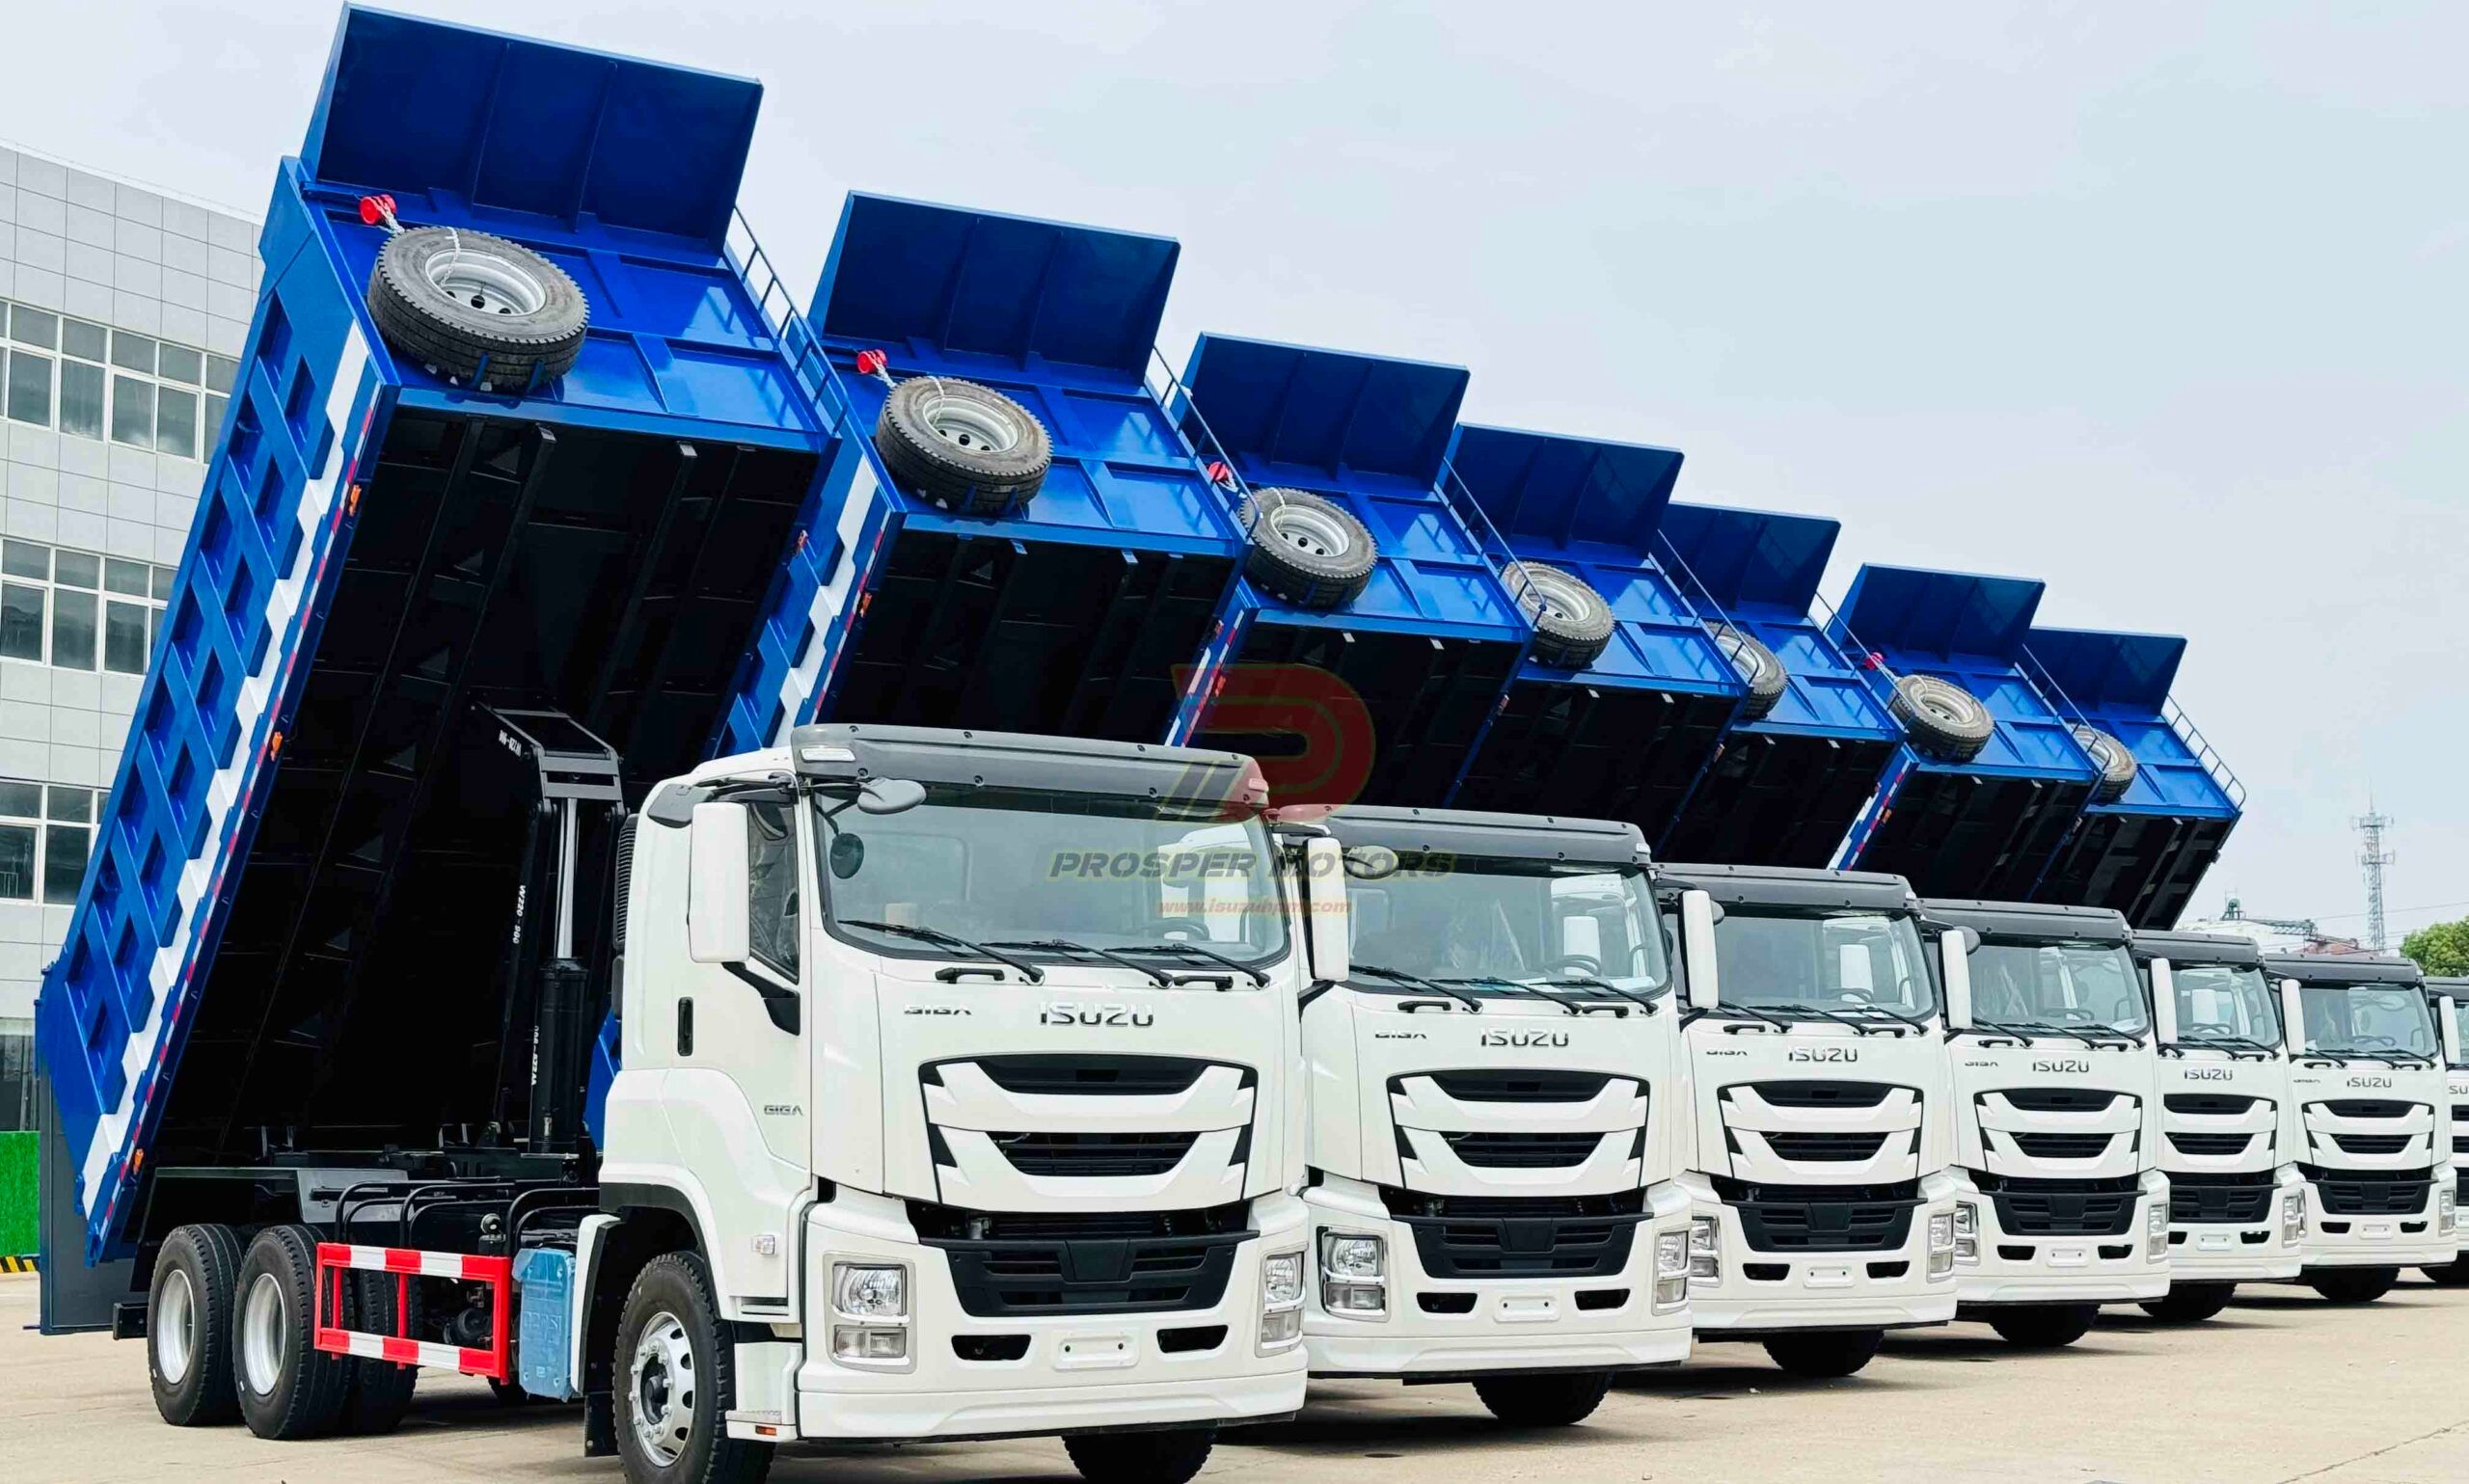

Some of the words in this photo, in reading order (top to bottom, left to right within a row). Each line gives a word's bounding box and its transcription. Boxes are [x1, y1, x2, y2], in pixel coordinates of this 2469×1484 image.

[1039, 1001, 1154, 1027] ISUZU
[1480, 1027, 1570, 1047] ISUZU
[1788, 1047, 1859, 1063] ISUZU
[2031, 1060, 2090, 1073] ISUZU
[2184, 1067, 2233, 1081] ISUZU
[2346, 1076, 2393, 1089] ISUZU
[763, 1104, 803, 1116] GIGA
